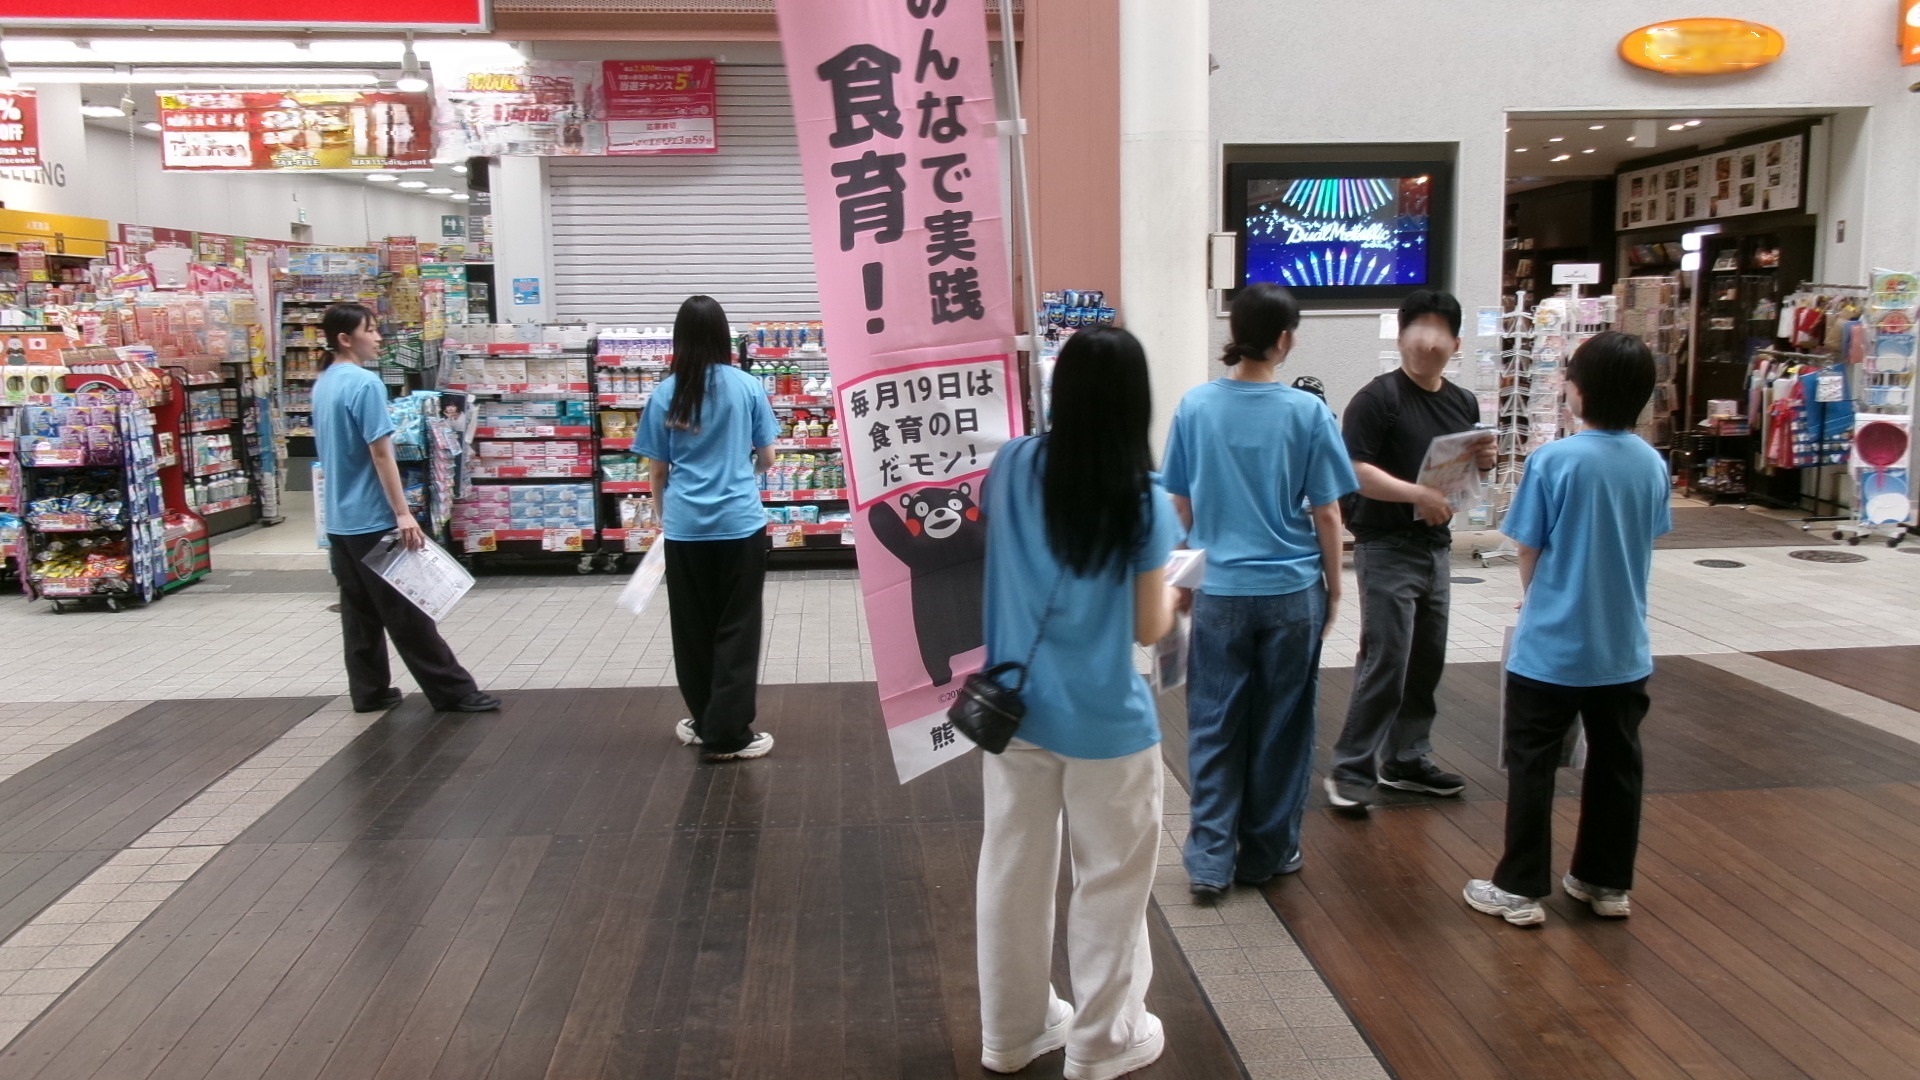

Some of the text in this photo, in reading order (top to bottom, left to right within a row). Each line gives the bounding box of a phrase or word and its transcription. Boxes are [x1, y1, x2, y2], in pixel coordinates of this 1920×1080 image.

[817, 43, 906, 335] 食育!
[850, 369, 994, 419] 毎月19日は
[868, 408, 979, 452] 食育の日
[879, 443, 977, 487] だモン!
[930, 720, 955, 751] 熊
